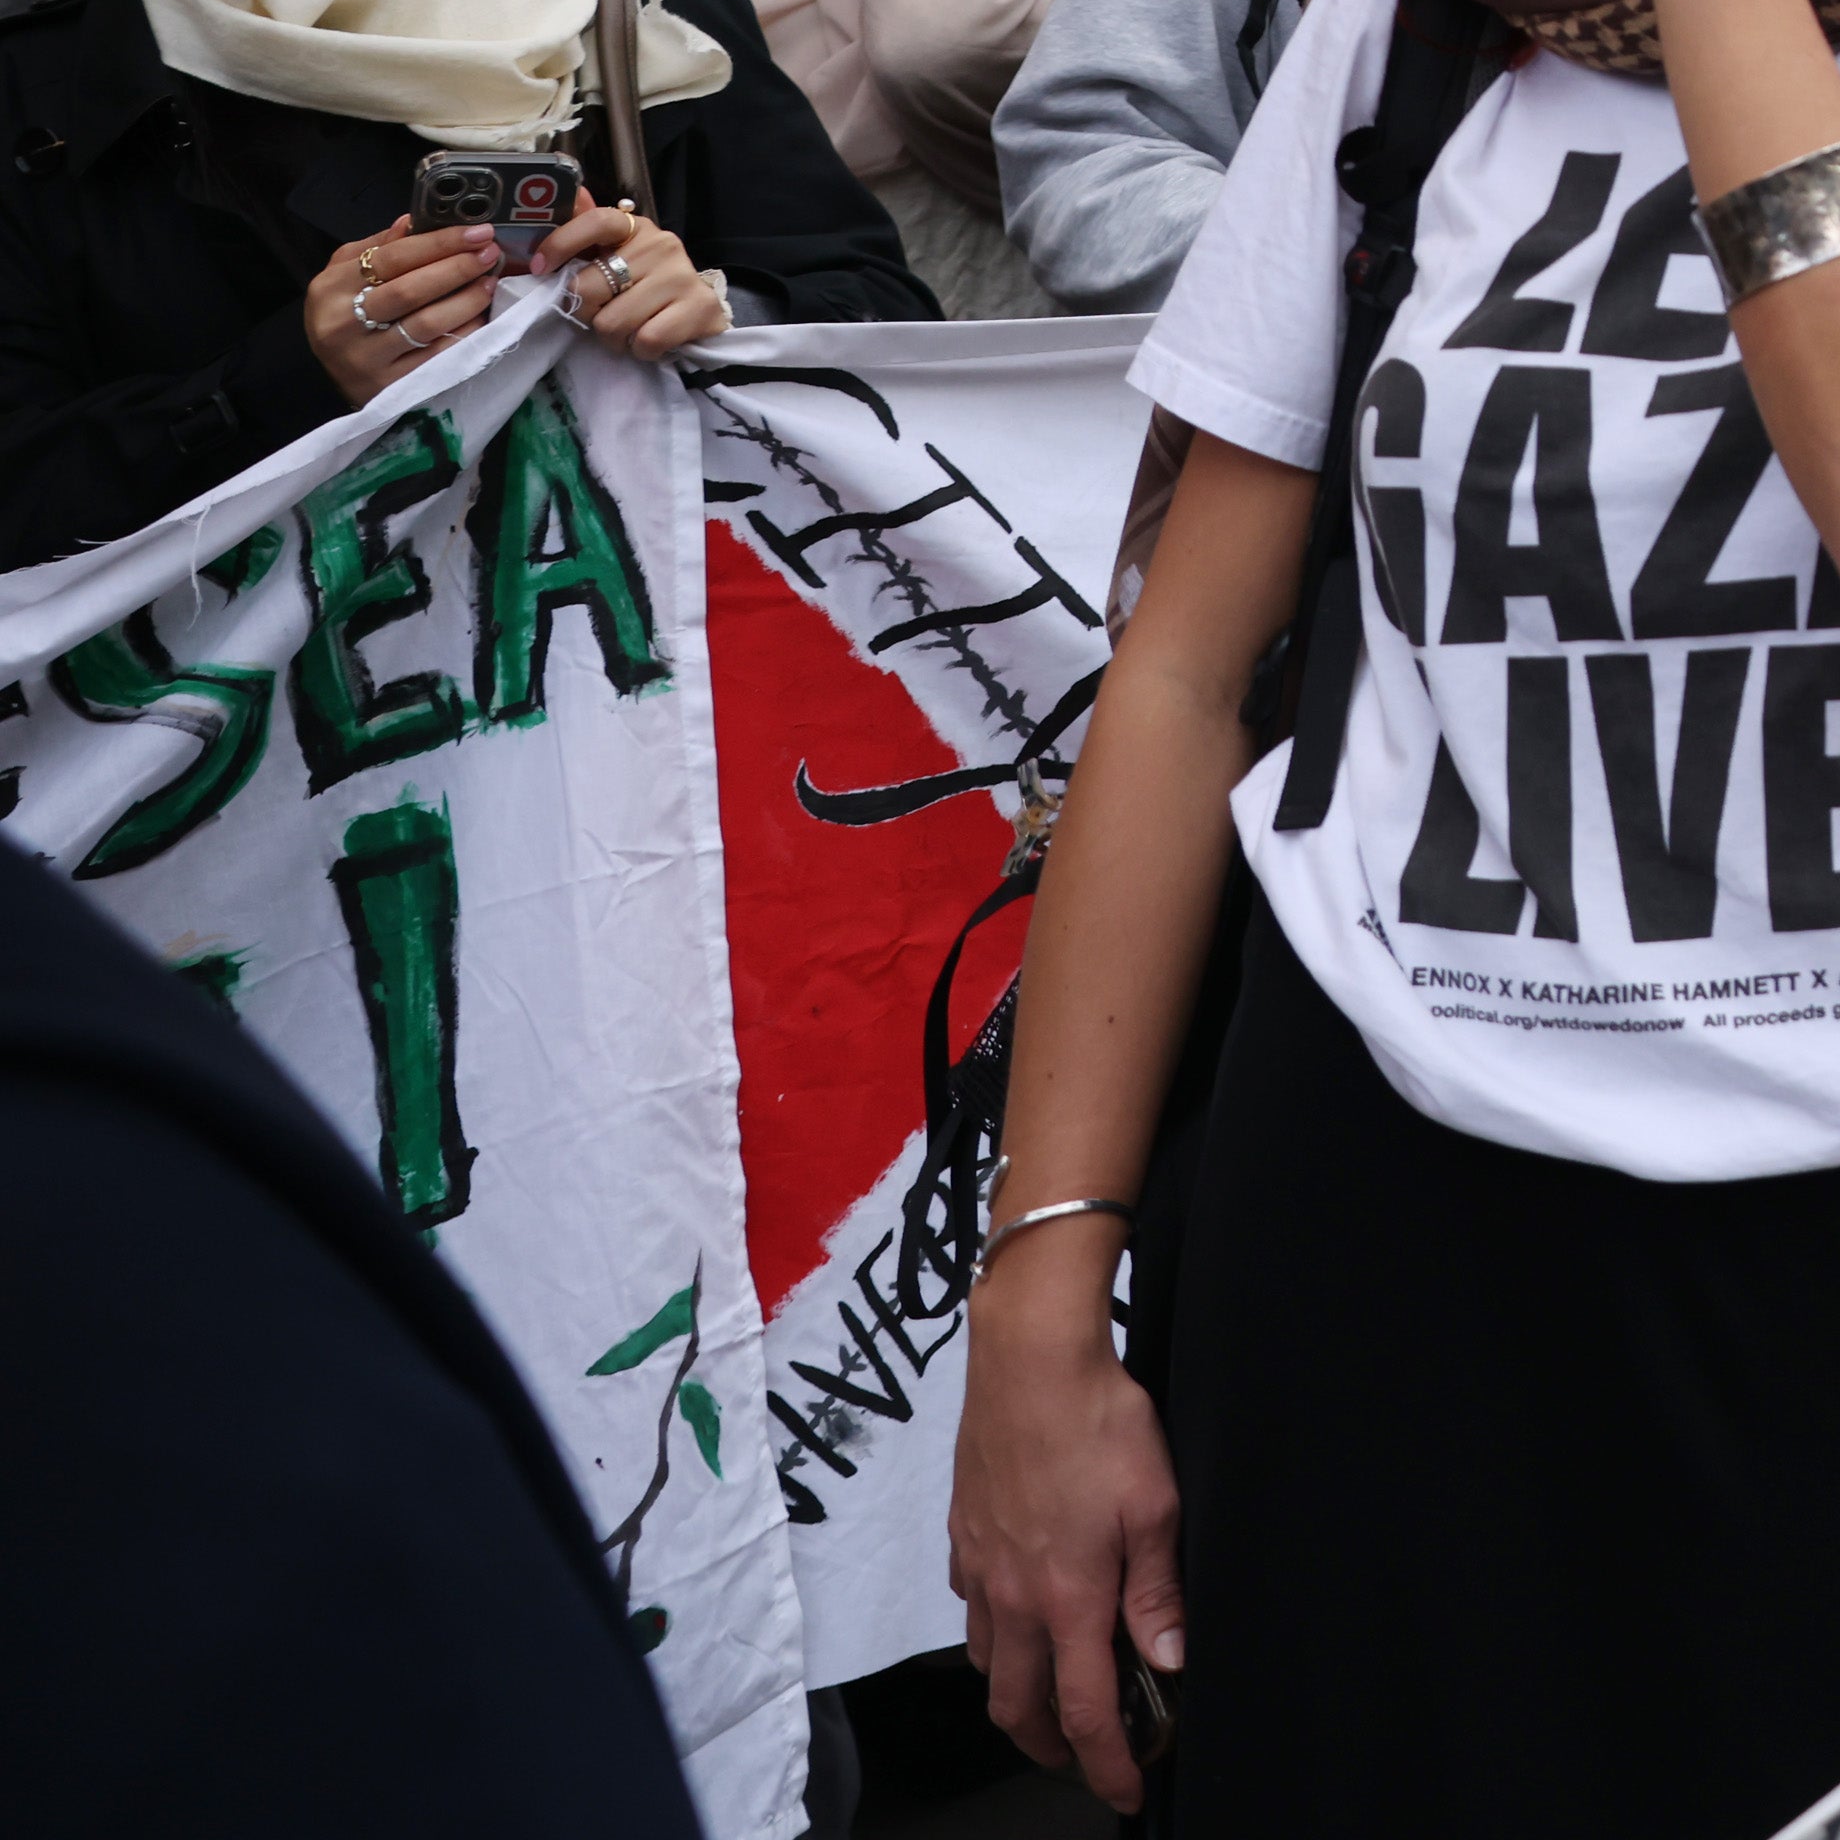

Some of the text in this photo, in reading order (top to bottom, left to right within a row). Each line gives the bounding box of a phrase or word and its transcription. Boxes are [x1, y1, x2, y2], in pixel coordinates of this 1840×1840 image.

[1411, 966, 1491, 996] ENNOX
[1498, 978, 1514, 999] X
[1522, 981, 1665, 1006] KATHARINE
[1673, 971, 1801, 1002] HAMNETT
[1811, 968, 1829, 990] X
[1703, 1013, 1727, 1029] All
[1733, 1004, 1826, 1029] proceeds
